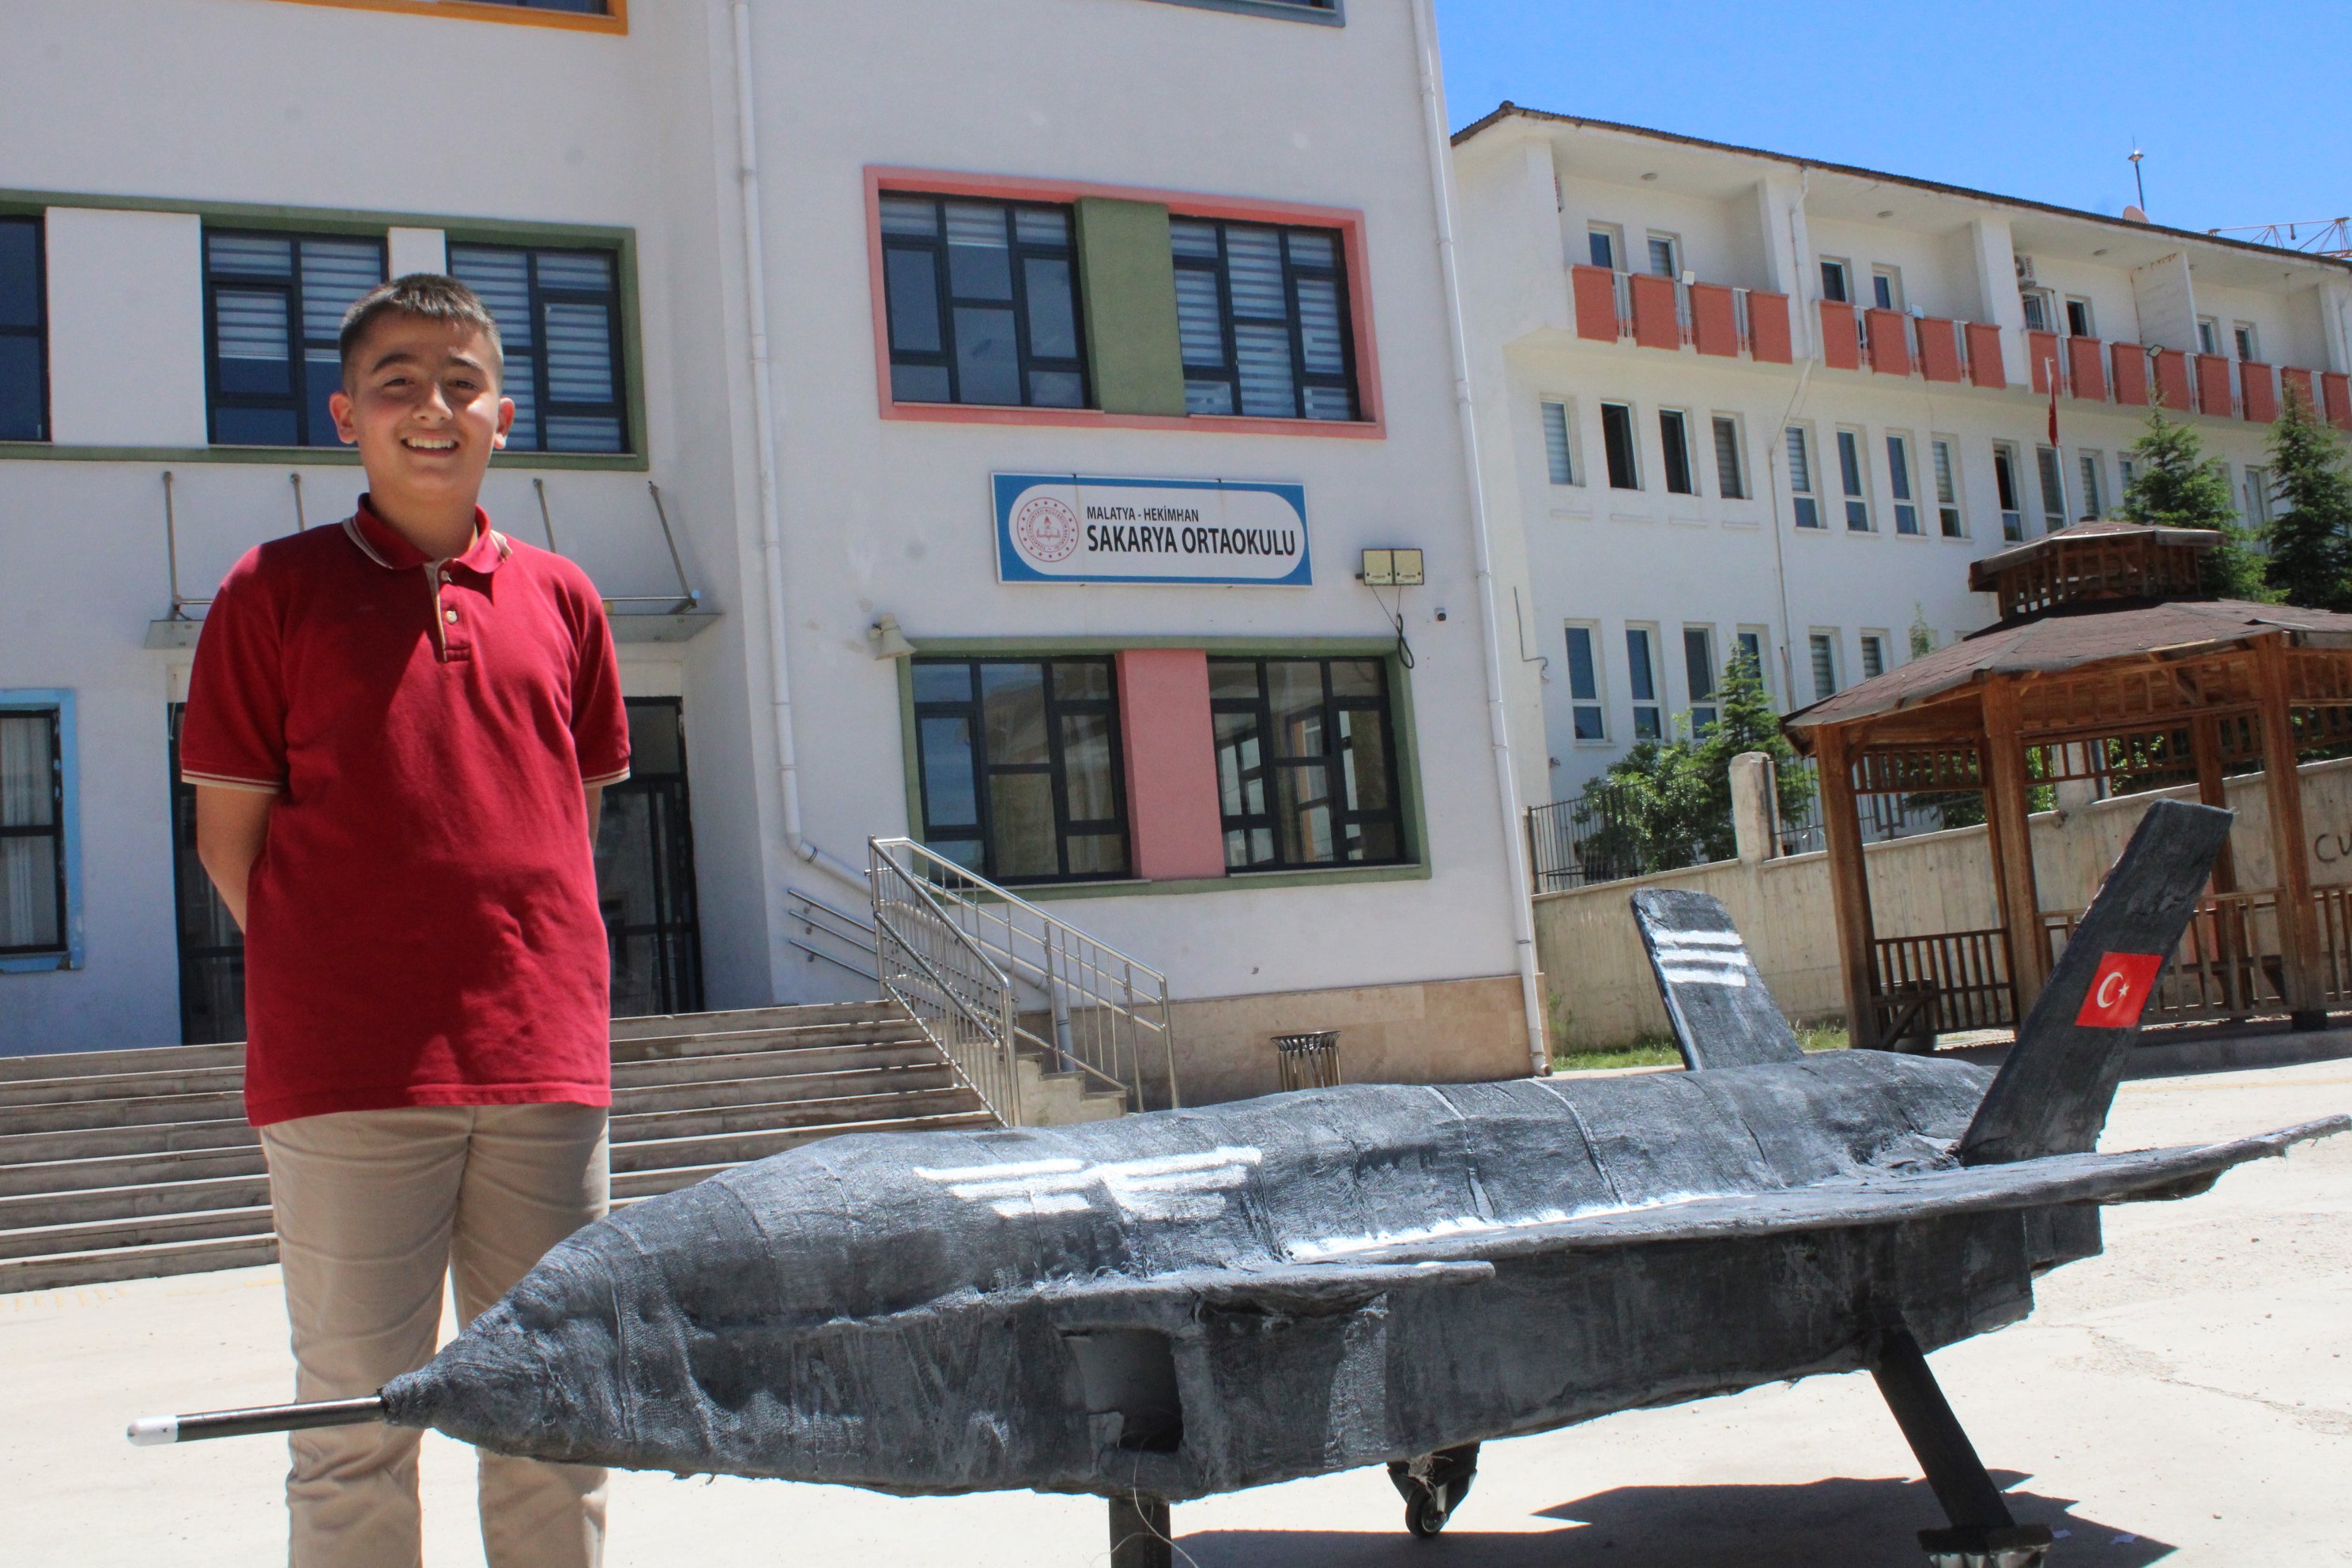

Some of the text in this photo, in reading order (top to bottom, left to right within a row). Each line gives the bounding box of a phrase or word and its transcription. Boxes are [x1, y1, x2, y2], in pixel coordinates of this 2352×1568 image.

[1087, 506, 1136, 521] MALATYA
[1144, 506, 1199, 522] HEKİMHAN
[1087, 525, 1178, 553] SAKARYA
[1182, 527, 1295, 556] ORTAOKULU
